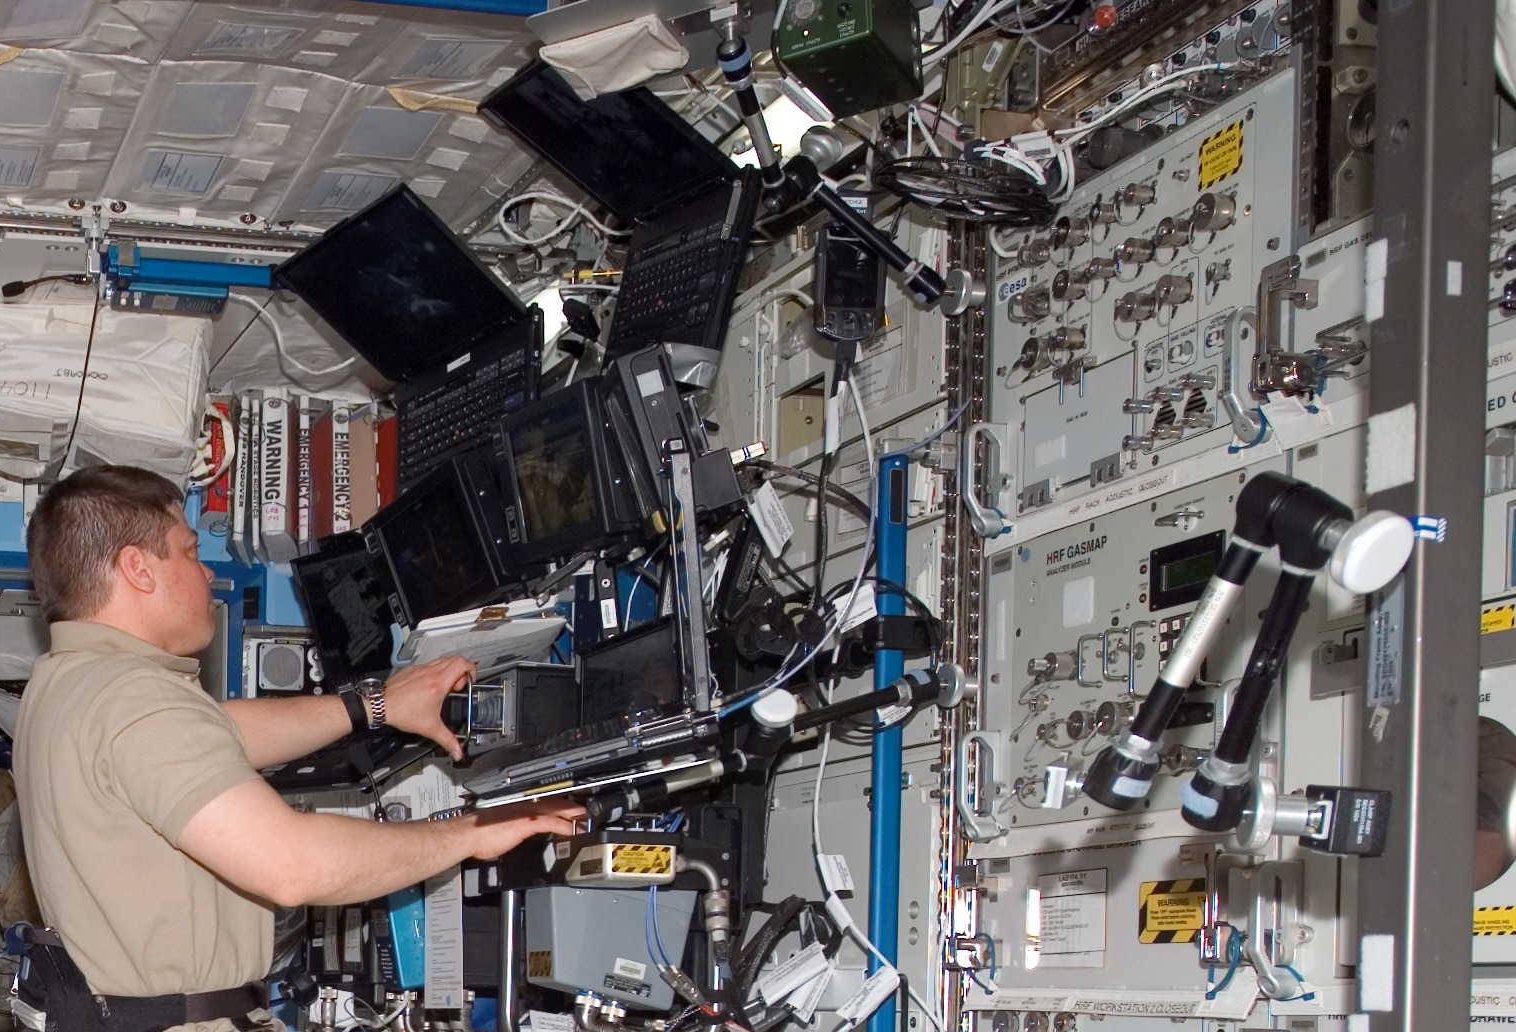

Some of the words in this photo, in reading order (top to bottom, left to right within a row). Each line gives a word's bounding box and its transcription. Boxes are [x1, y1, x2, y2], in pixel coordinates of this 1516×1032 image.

[264, 420, 282, 501] WARNING
[299, 428, 310, 501] EMERGENCY
[334, 432, 350, 509] EMERGENCY
[1046, 549, 1065, 566] HRF
[1066, 536, 1108, 560] GASMAP
[1157, 898, 1190, 907] WARNING
[1093, 1001, 1148, 1013] WORKSTATION
[1155, 1003, 1196, 1014] CLOSEOUT
